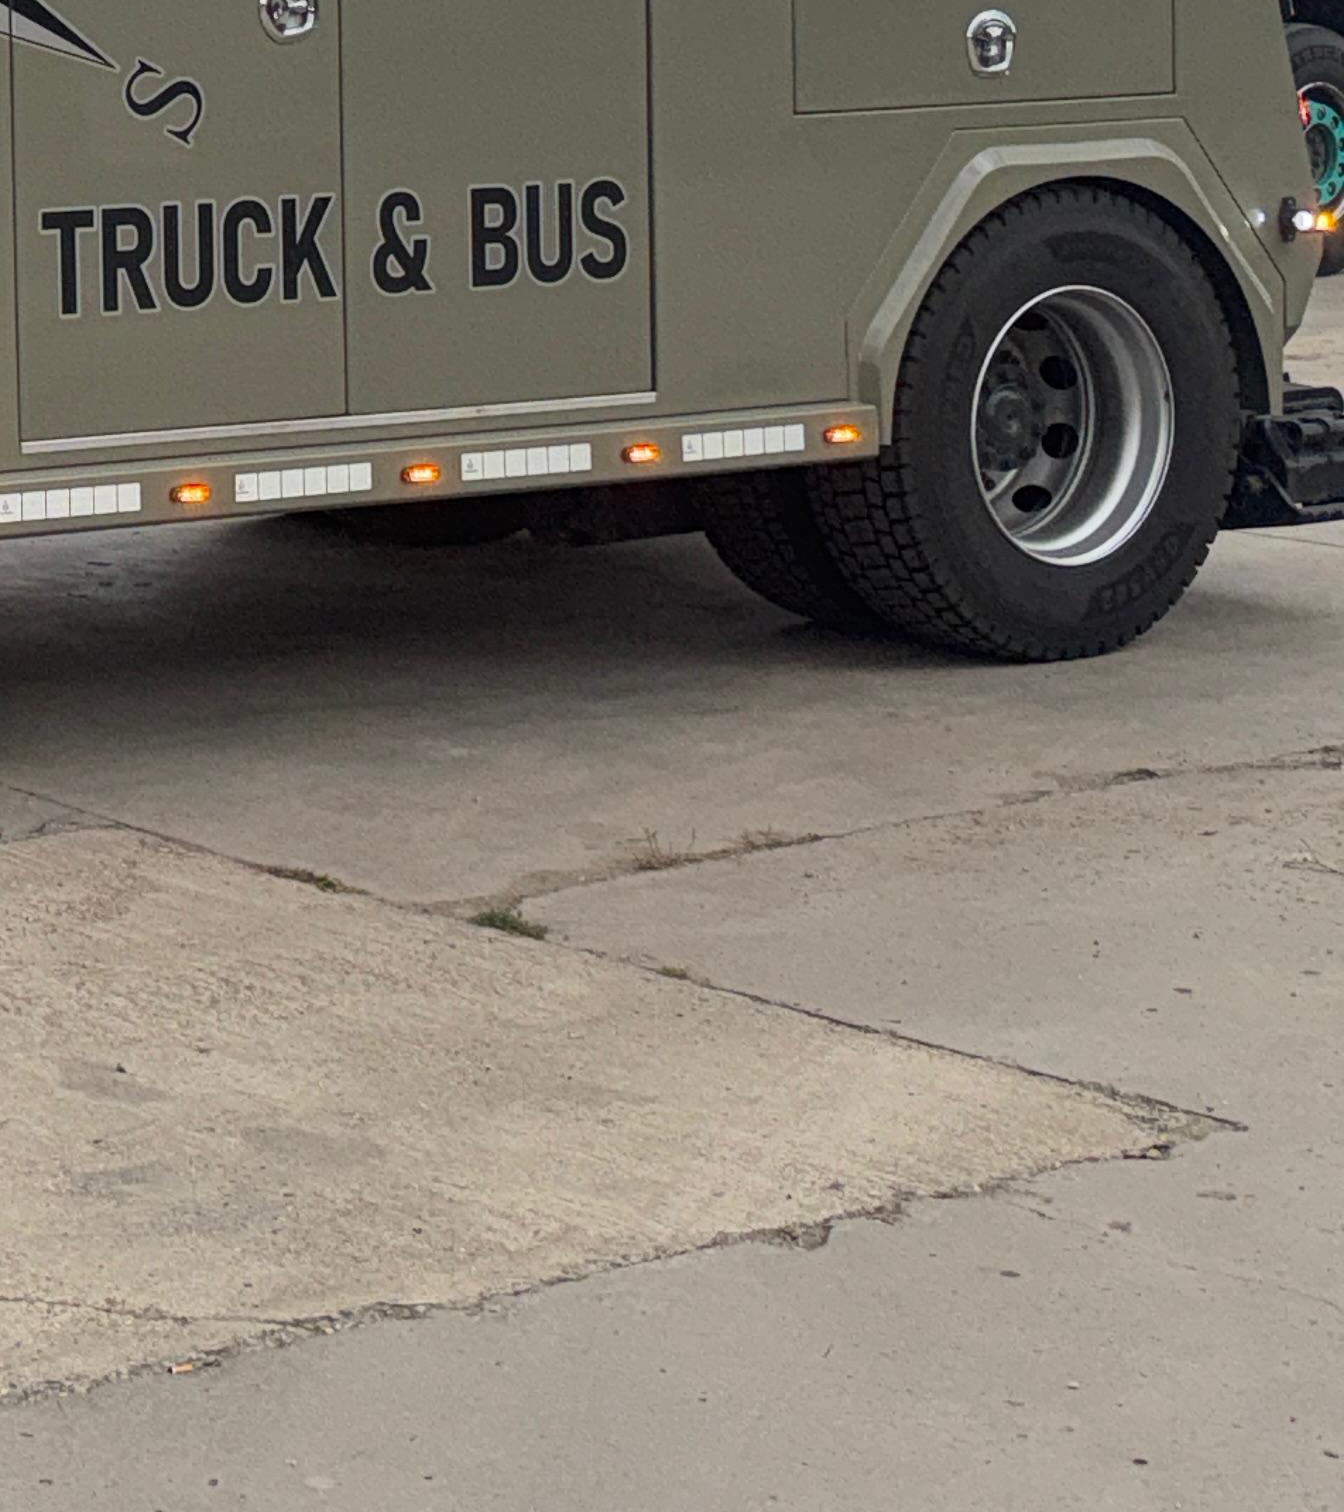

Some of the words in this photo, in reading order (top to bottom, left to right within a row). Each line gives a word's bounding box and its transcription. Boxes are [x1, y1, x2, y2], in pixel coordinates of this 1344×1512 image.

[124, 57, 204, 147] S
[40, 192, 337, 318] TRUCK
[372, 188, 432, 293] &
[469, 177, 629, 288] BUS
